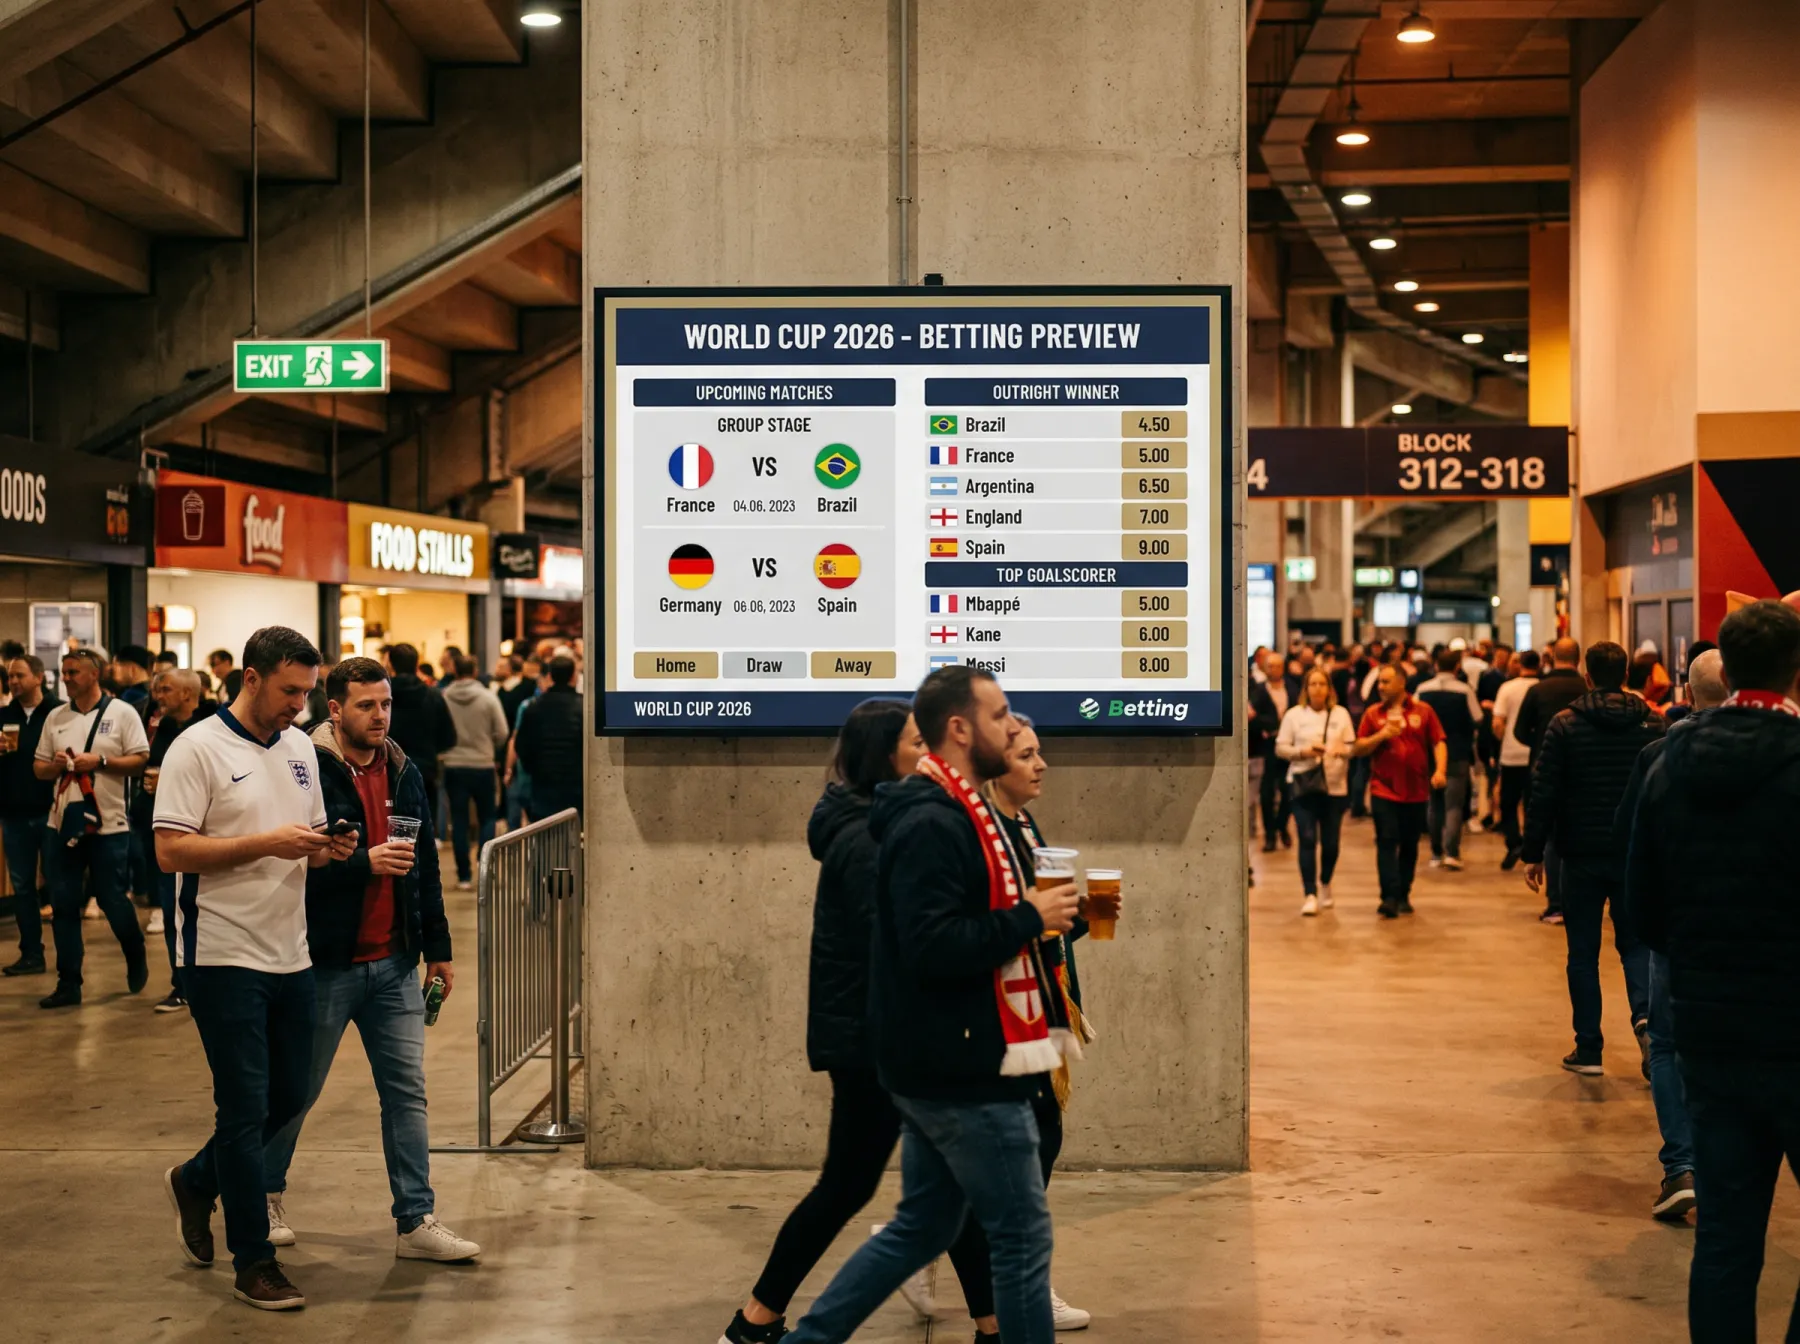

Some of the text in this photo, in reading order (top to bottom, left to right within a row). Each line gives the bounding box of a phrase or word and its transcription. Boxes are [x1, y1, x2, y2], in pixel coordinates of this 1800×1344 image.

[683, 323, 771, 350] WORLD
[778, 323, 827, 350] CUP
[833, 323, 895, 350] 2026
[919, 323, 1023, 349] BETTING
[1031, 323, 1141, 349] PREVIEW
[245, 354, 293, 379] EXIT
[696, 384, 833, 401] UPCOMING MATCHES
[993, 384, 1120, 400] OUTRIGHT WINNER
[717, 417, 812, 433] GROUP STAGE
[965, 416, 1006, 433] Brazil
[1138, 416, 1170, 433] 4.50
[1397, 432, 1473, 454] BLOCK
[965, 447, 1015, 464] France
[1139, 447, 1170, 464] 5.00
[751, 456, 778, 477] VS
[1397, 456, 1547, 491] 312-318
[965, 477, 1035, 498] Argentina
[1138, 477, 1170, 494] 6.50
[666, 496, 716, 513] France
[768, 499, 796, 513] 2023
[817, 496, 857, 513] Brazil
[965, 508, 1022, 529] England
[1139, 508, 1169, 525] 7.00
[243, 494, 286, 564] food
[371, 521, 417, 572] FOOD
[417, 528, 474, 577] STALLS
[965, 538, 1005, 559] Spain
[1138, 539, 1170, 556] 9.00
[751, 557, 778, 579] VS
[996, 567, 1117, 583] TOP GOALSCORER
[659, 596, 723, 617] Germany
[768, 599, 796, 613] 2023
[817, 596, 857, 617] Spain
[965, 595, 1021, 616] Mbappé
[1139, 595, 1170, 612] 5.00
[966, 626, 1002, 642] Kane
[1139, 626, 1170, 642] 6.00
[656, 657, 696, 673] Home
[746, 657, 783, 673] Draw
[834, 657, 873, 677] Away
[966, 656, 1006, 673] Messi
[1139, 656, 1170, 673] 8.00
[633, 701, 752, 717] WORLD CUP 2026
[1108, 698, 1189, 722] Betting
